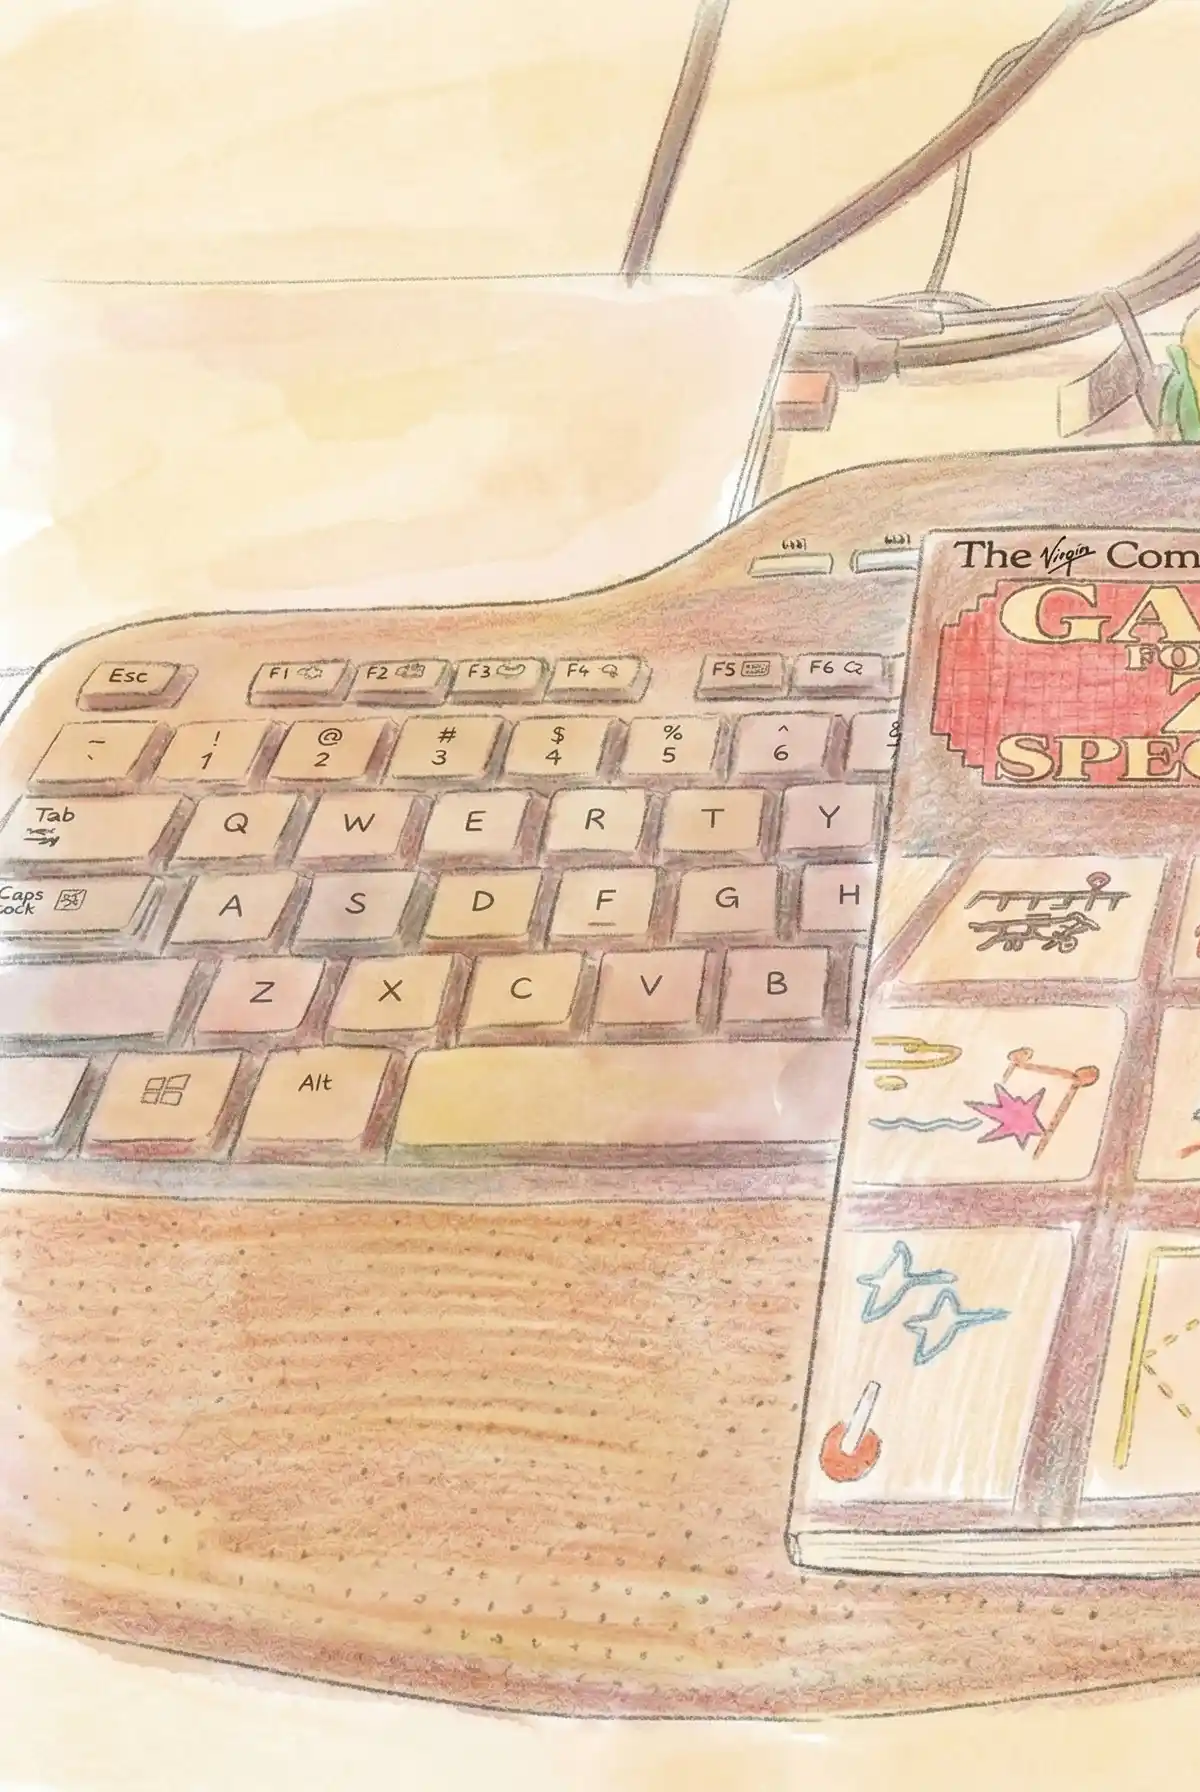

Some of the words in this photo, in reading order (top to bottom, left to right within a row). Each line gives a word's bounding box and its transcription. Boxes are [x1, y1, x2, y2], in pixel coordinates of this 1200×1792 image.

[954, 541, 1031, 568] The
[1040, 536, 1096, 576] Virgin
[109, 668, 147, 683] Esc
[270, 667, 288, 679] F1
[367, 663, 390, 679] F2
[468, 663, 490, 678] F3
[566, 663, 589, 677] F4
[713, 661, 735, 676] F5
[810, 660, 834, 673] F6
[318, 728, 342, 746] @
[438, 727, 456, 743] #
[551, 727, 565, 744] $
[664, 725, 682, 740] %
[202, 752, 212, 769] 1
[314, 752, 330, 767] 2
[432, 750, 446, 765] 3
[546, 749, 561, 765] 4
[663, 747, 675, 763] 5
[774, 747, 788, 760] 6
[36, 807, 75, 822] Tab
[224, 813, 248, 834] Q
[345, 814, 375, 832] W
[466, 811, 486, 831] E
[585, 808, 605, 829] R
[701, 809, 724, 828] T
[819, 806, 840, 828] Y
[0, 884, 45, 908] Caps
[472, 891, 494, 911] D
[596, 890, 616, 910] F
[716, 887, 738, 908] G
[840, 884, 859, 904] H
[219, 895, 242, 917] A
[345, 893, 365, 914] S
[250, 982, 275, 1003] Z
[378, 980, 402, 1001] X
[511, 977, 532, 999] C
[641, 975, 662, 996] V
[767, 972, 787, 995] B
[298, 1074, 332, 1091] Alt
